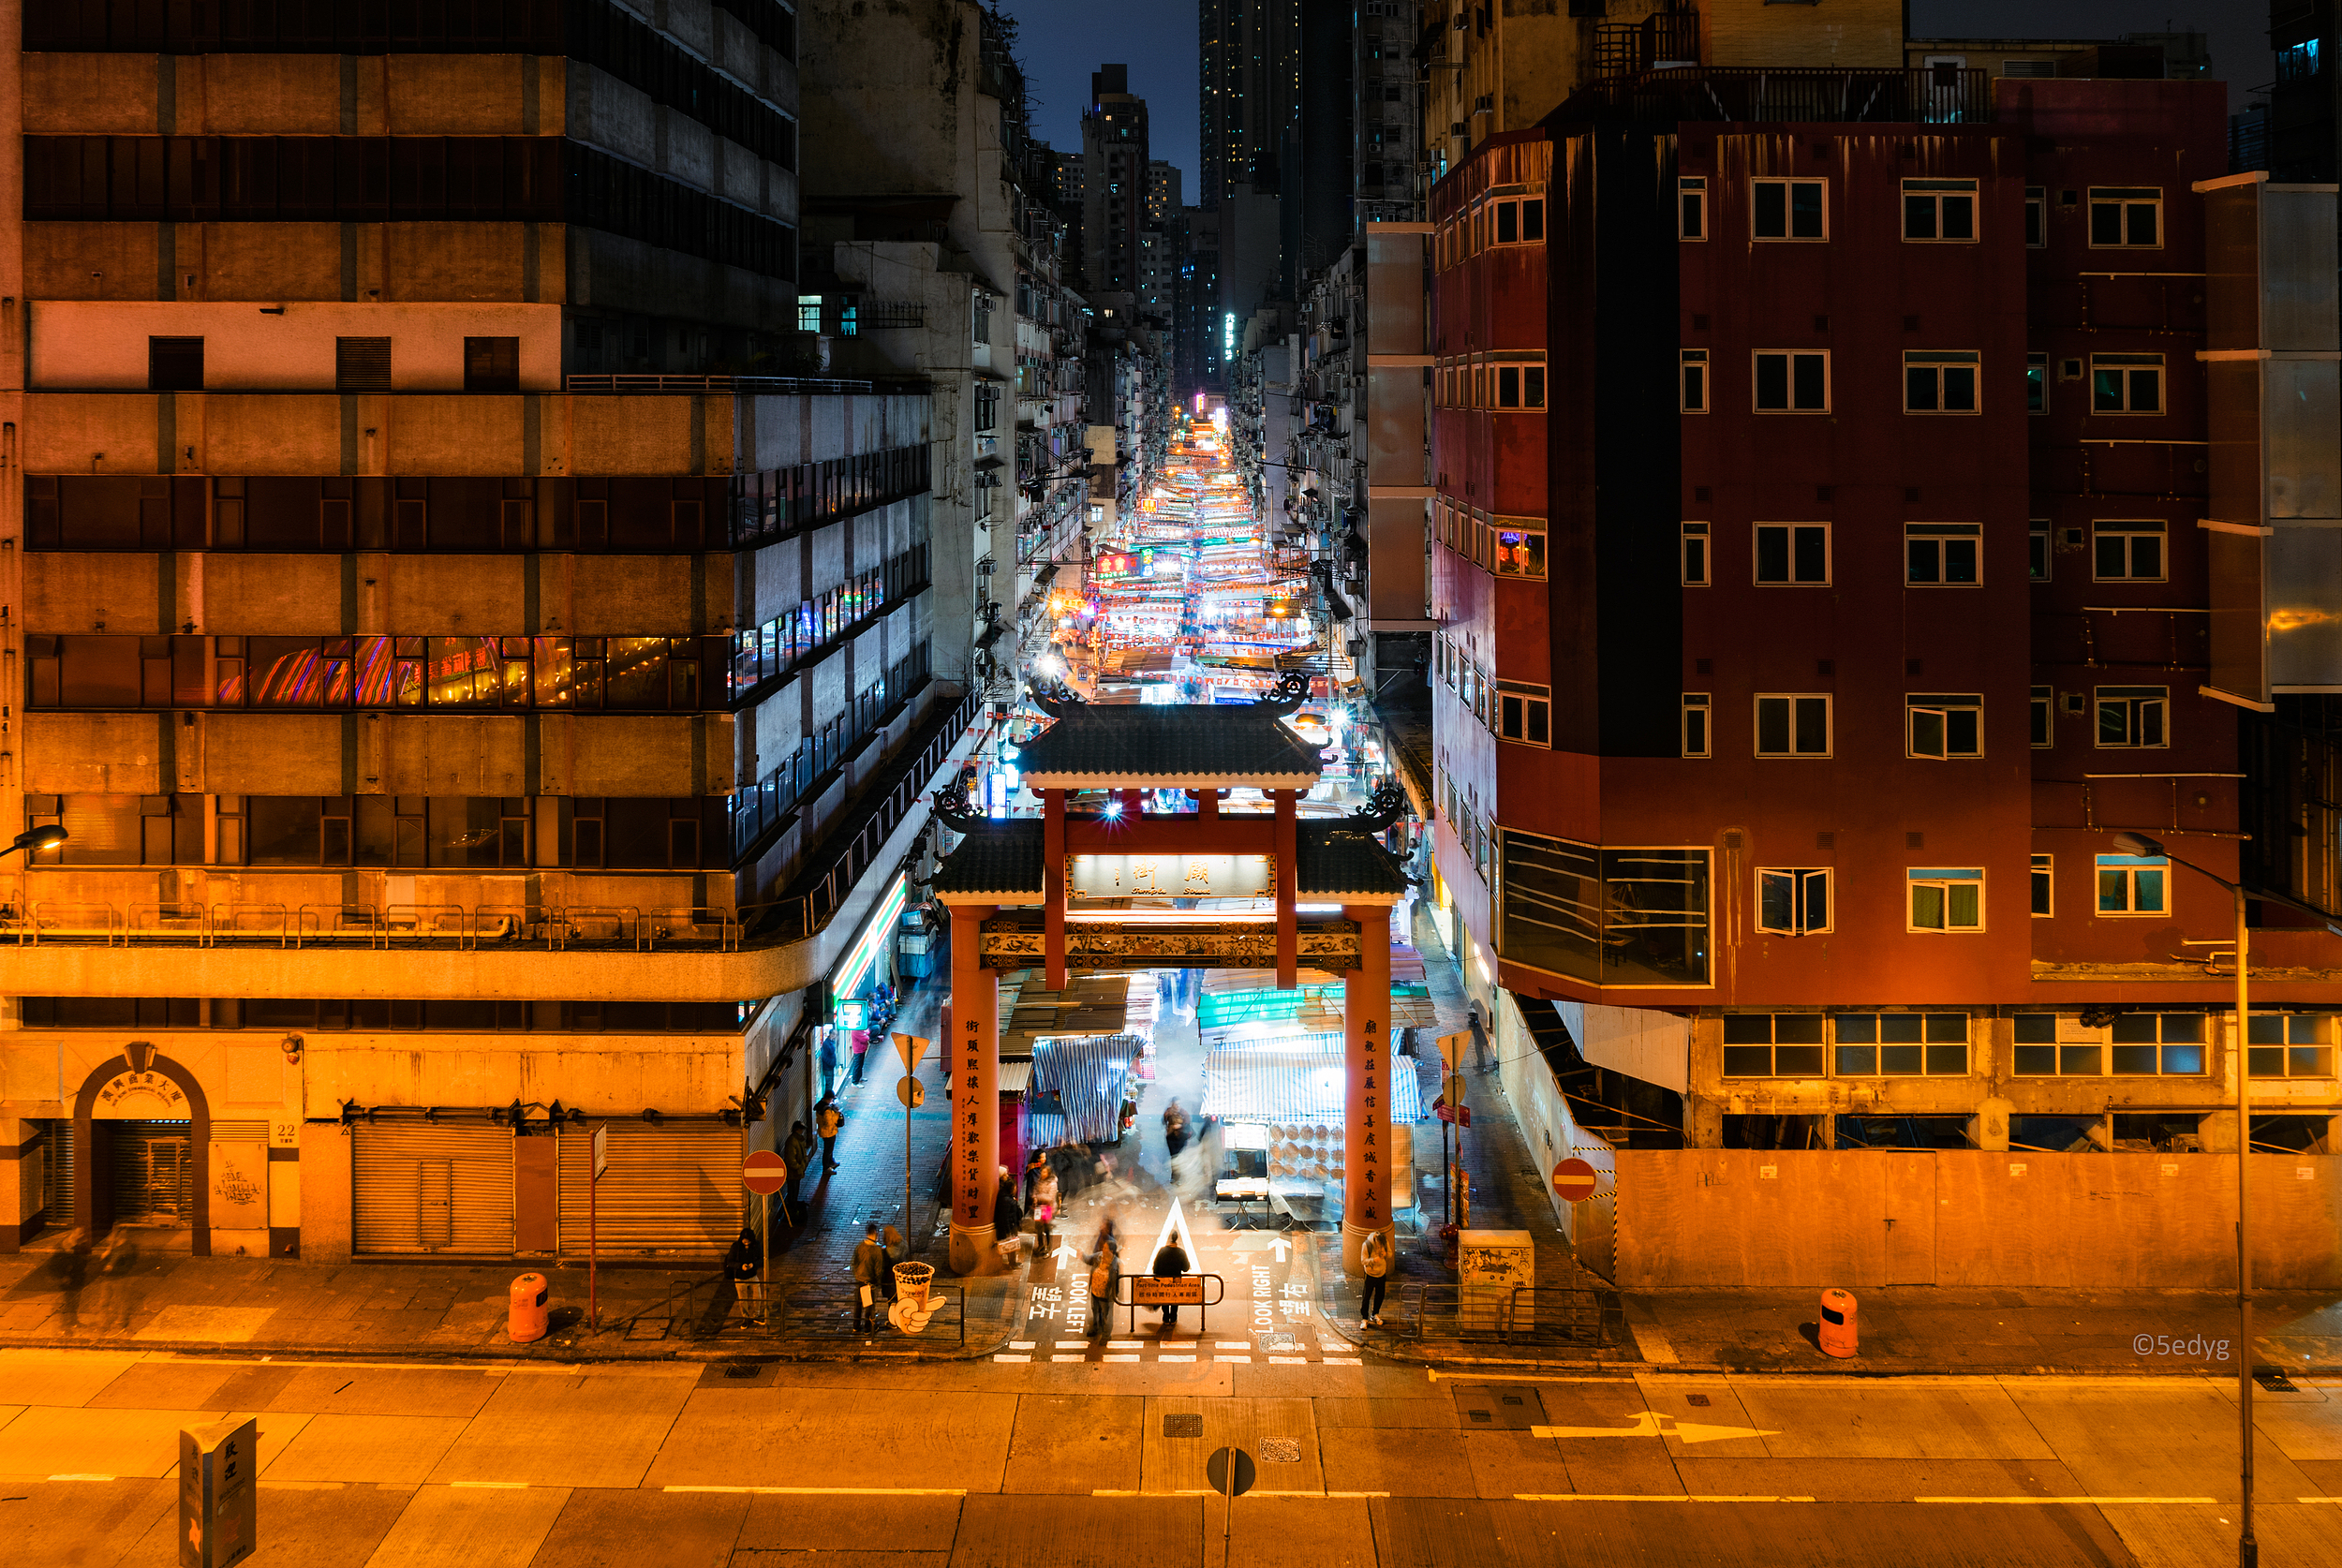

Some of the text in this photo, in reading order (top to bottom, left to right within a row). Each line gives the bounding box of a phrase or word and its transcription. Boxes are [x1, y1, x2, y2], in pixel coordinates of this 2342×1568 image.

[1132, 887, 1210, 895] Temple Street
[277, 1124, 295, 1136] 22
[1064, 1273, 1089, 1334] LOOK LEFT
[1251, 1264, 1274, 1334] LOOK RIGHT
